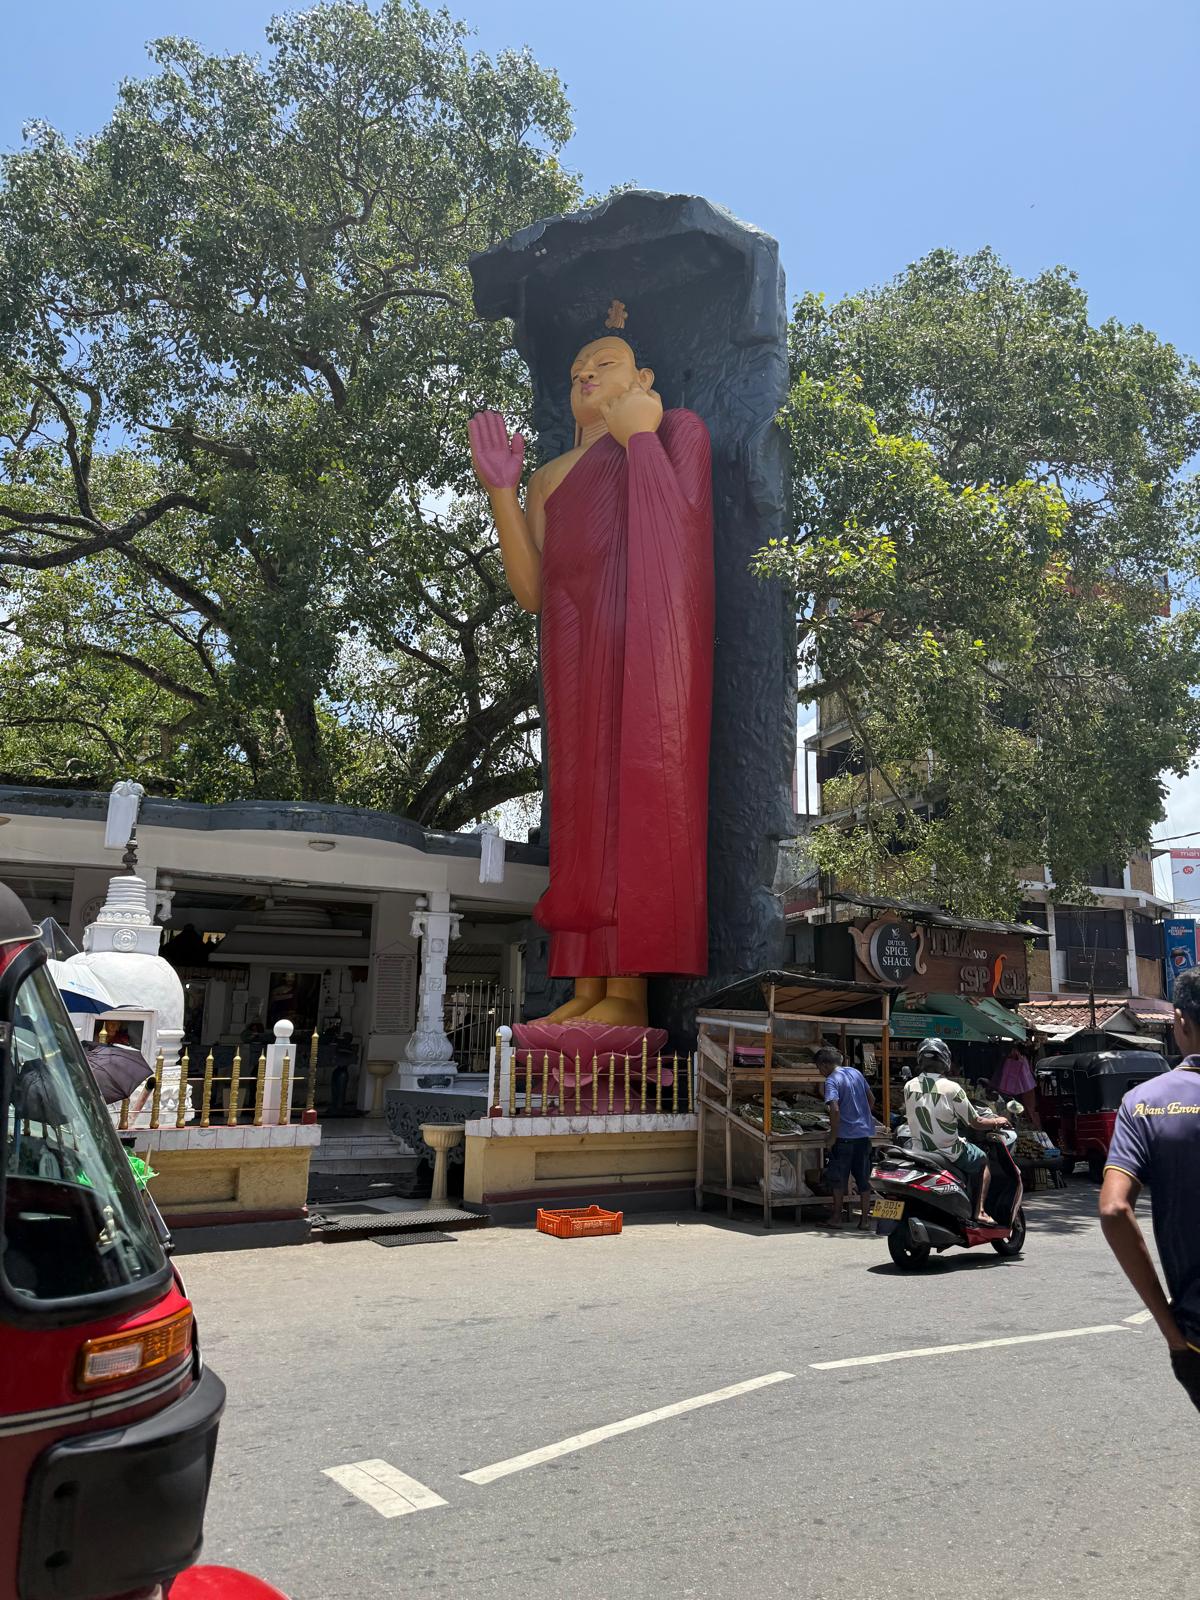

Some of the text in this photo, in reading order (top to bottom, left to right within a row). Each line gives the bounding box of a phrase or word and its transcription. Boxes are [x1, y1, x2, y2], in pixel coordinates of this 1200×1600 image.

[887, 939, 906, 947] DUTCH
[927, 927, 974, 959] TEA
[885, 946, 909, 956] SPICE
[882, 956, 911, 967] SHACK
[1132, 1102, 1166, 1117] Abans
